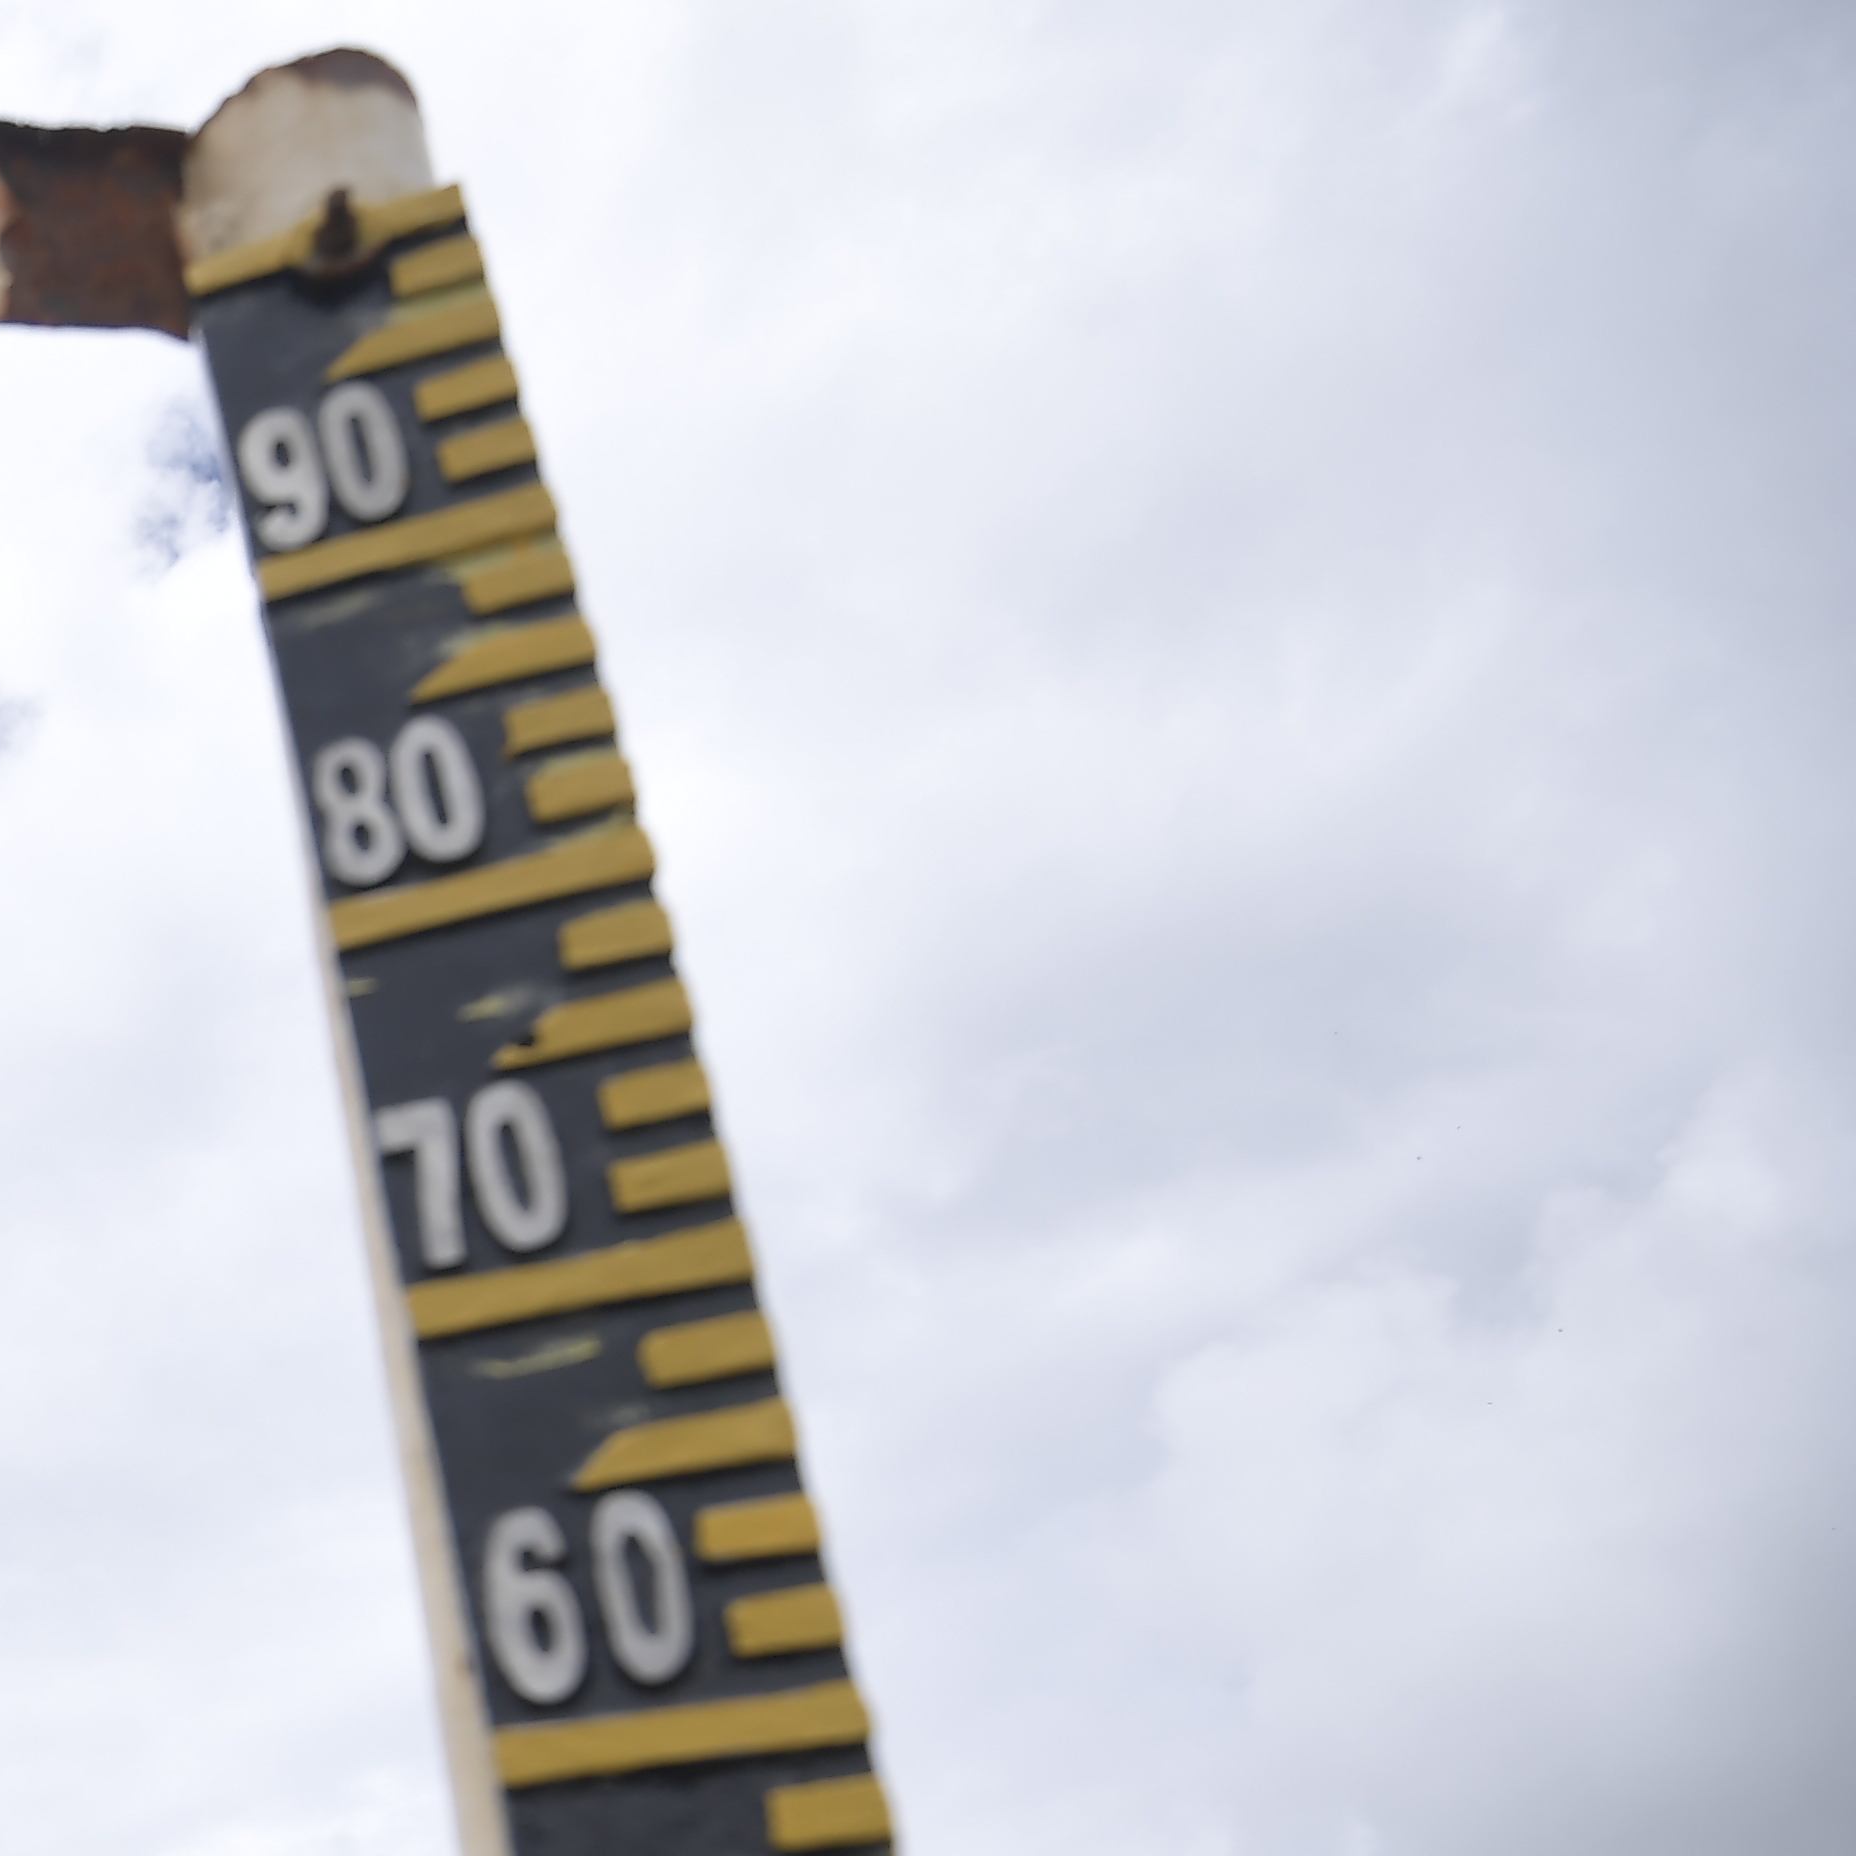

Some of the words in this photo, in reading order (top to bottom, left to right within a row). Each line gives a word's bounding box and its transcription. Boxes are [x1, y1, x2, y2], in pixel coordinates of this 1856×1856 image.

[238, 382, 410, 550] 90
[312, 715, 488, 886] 80
[377, 1078, 568, 1268] 70
[484, 1490, 692, 1705] 60
